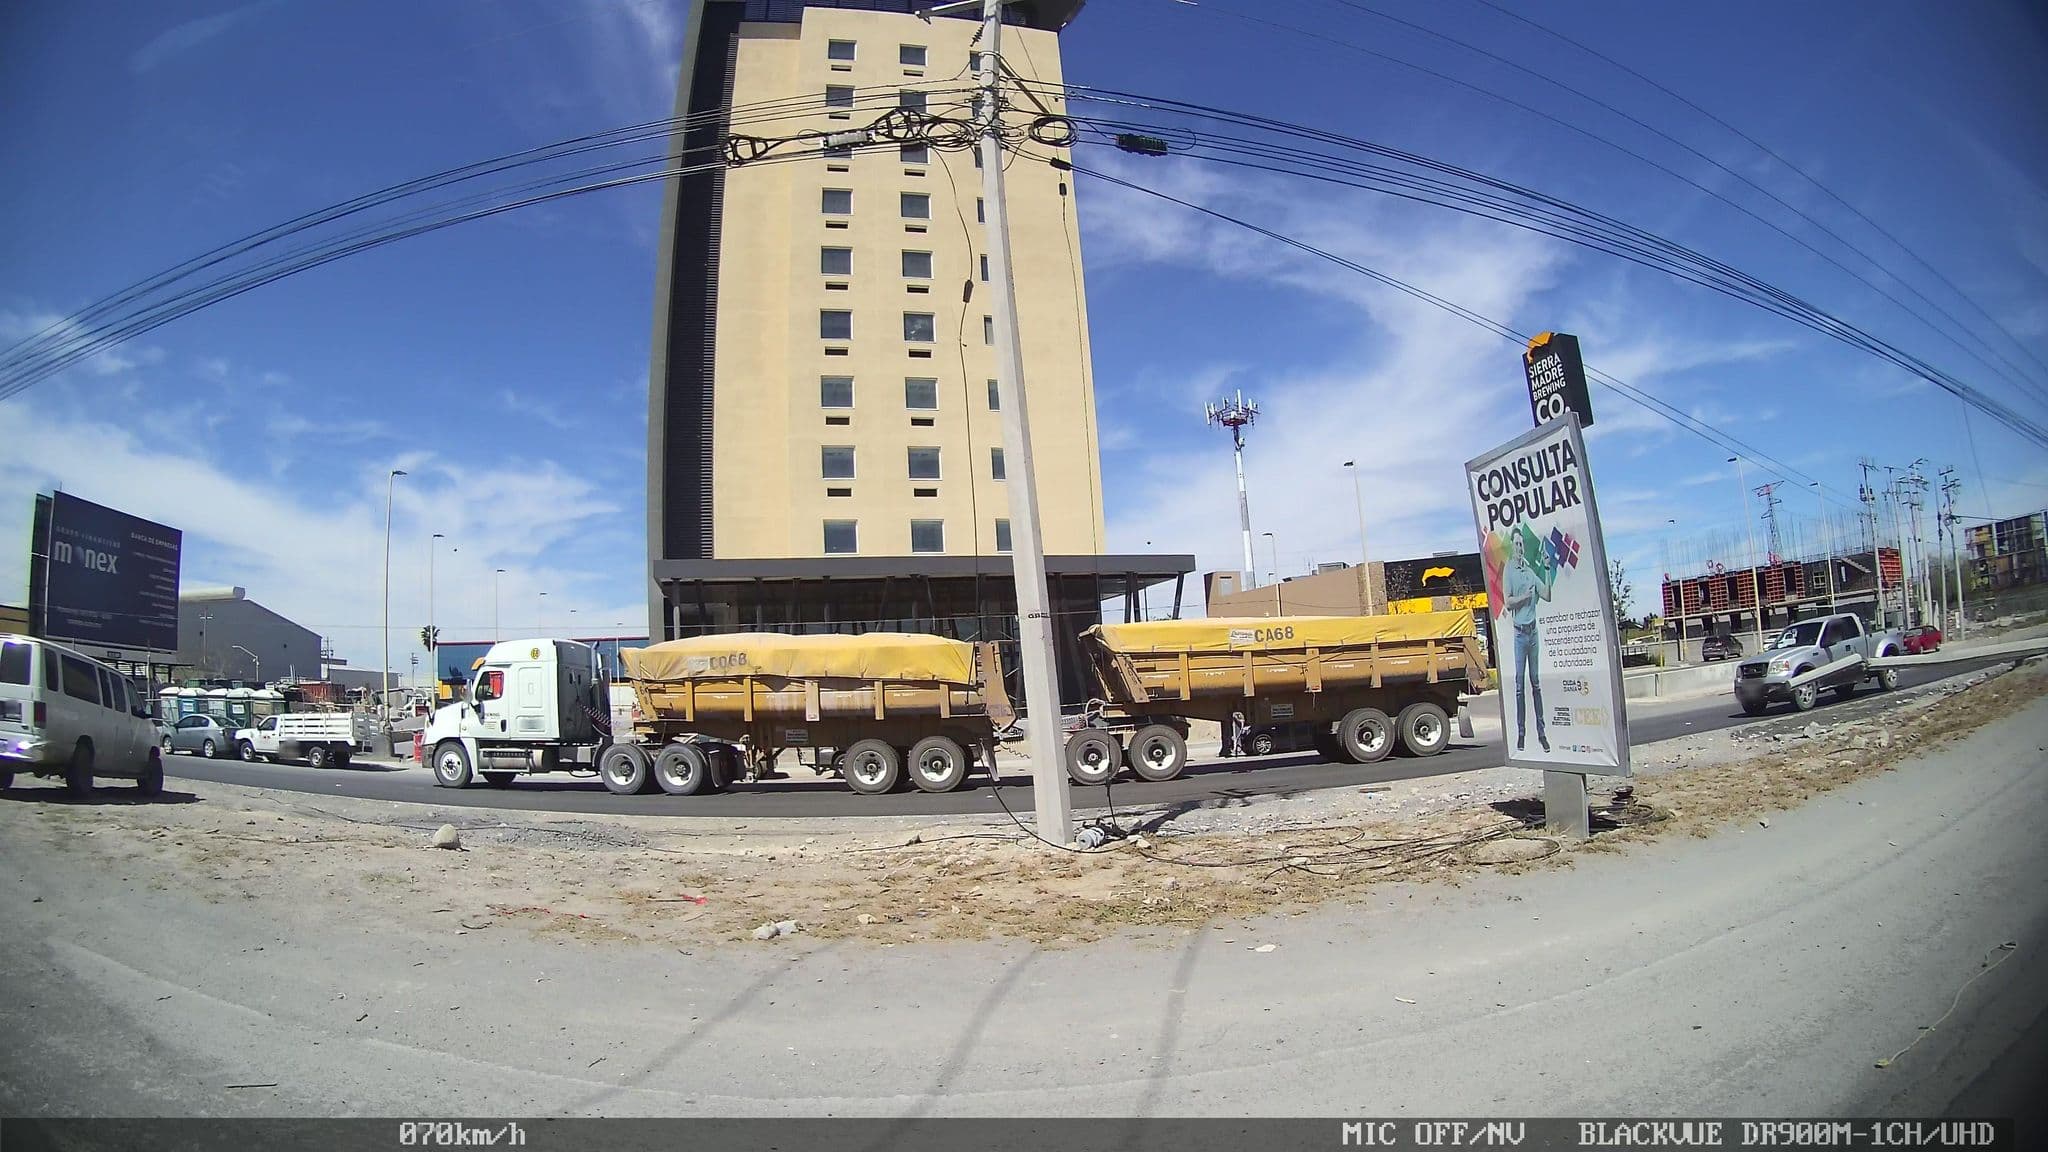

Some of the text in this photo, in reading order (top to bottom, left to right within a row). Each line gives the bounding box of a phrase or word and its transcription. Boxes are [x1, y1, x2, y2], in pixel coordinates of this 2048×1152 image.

[1528, 352, 1561, 378] SIERRA
[1531, 364, 1564, 391] MADRE
[1533, 377, 1566, 401] BREWING
[1477, 439, 1578, 502] CONSULTA
[1487, 475, 1581, 531] POPULAR
[1254, 626, 1294, 642] CA68
